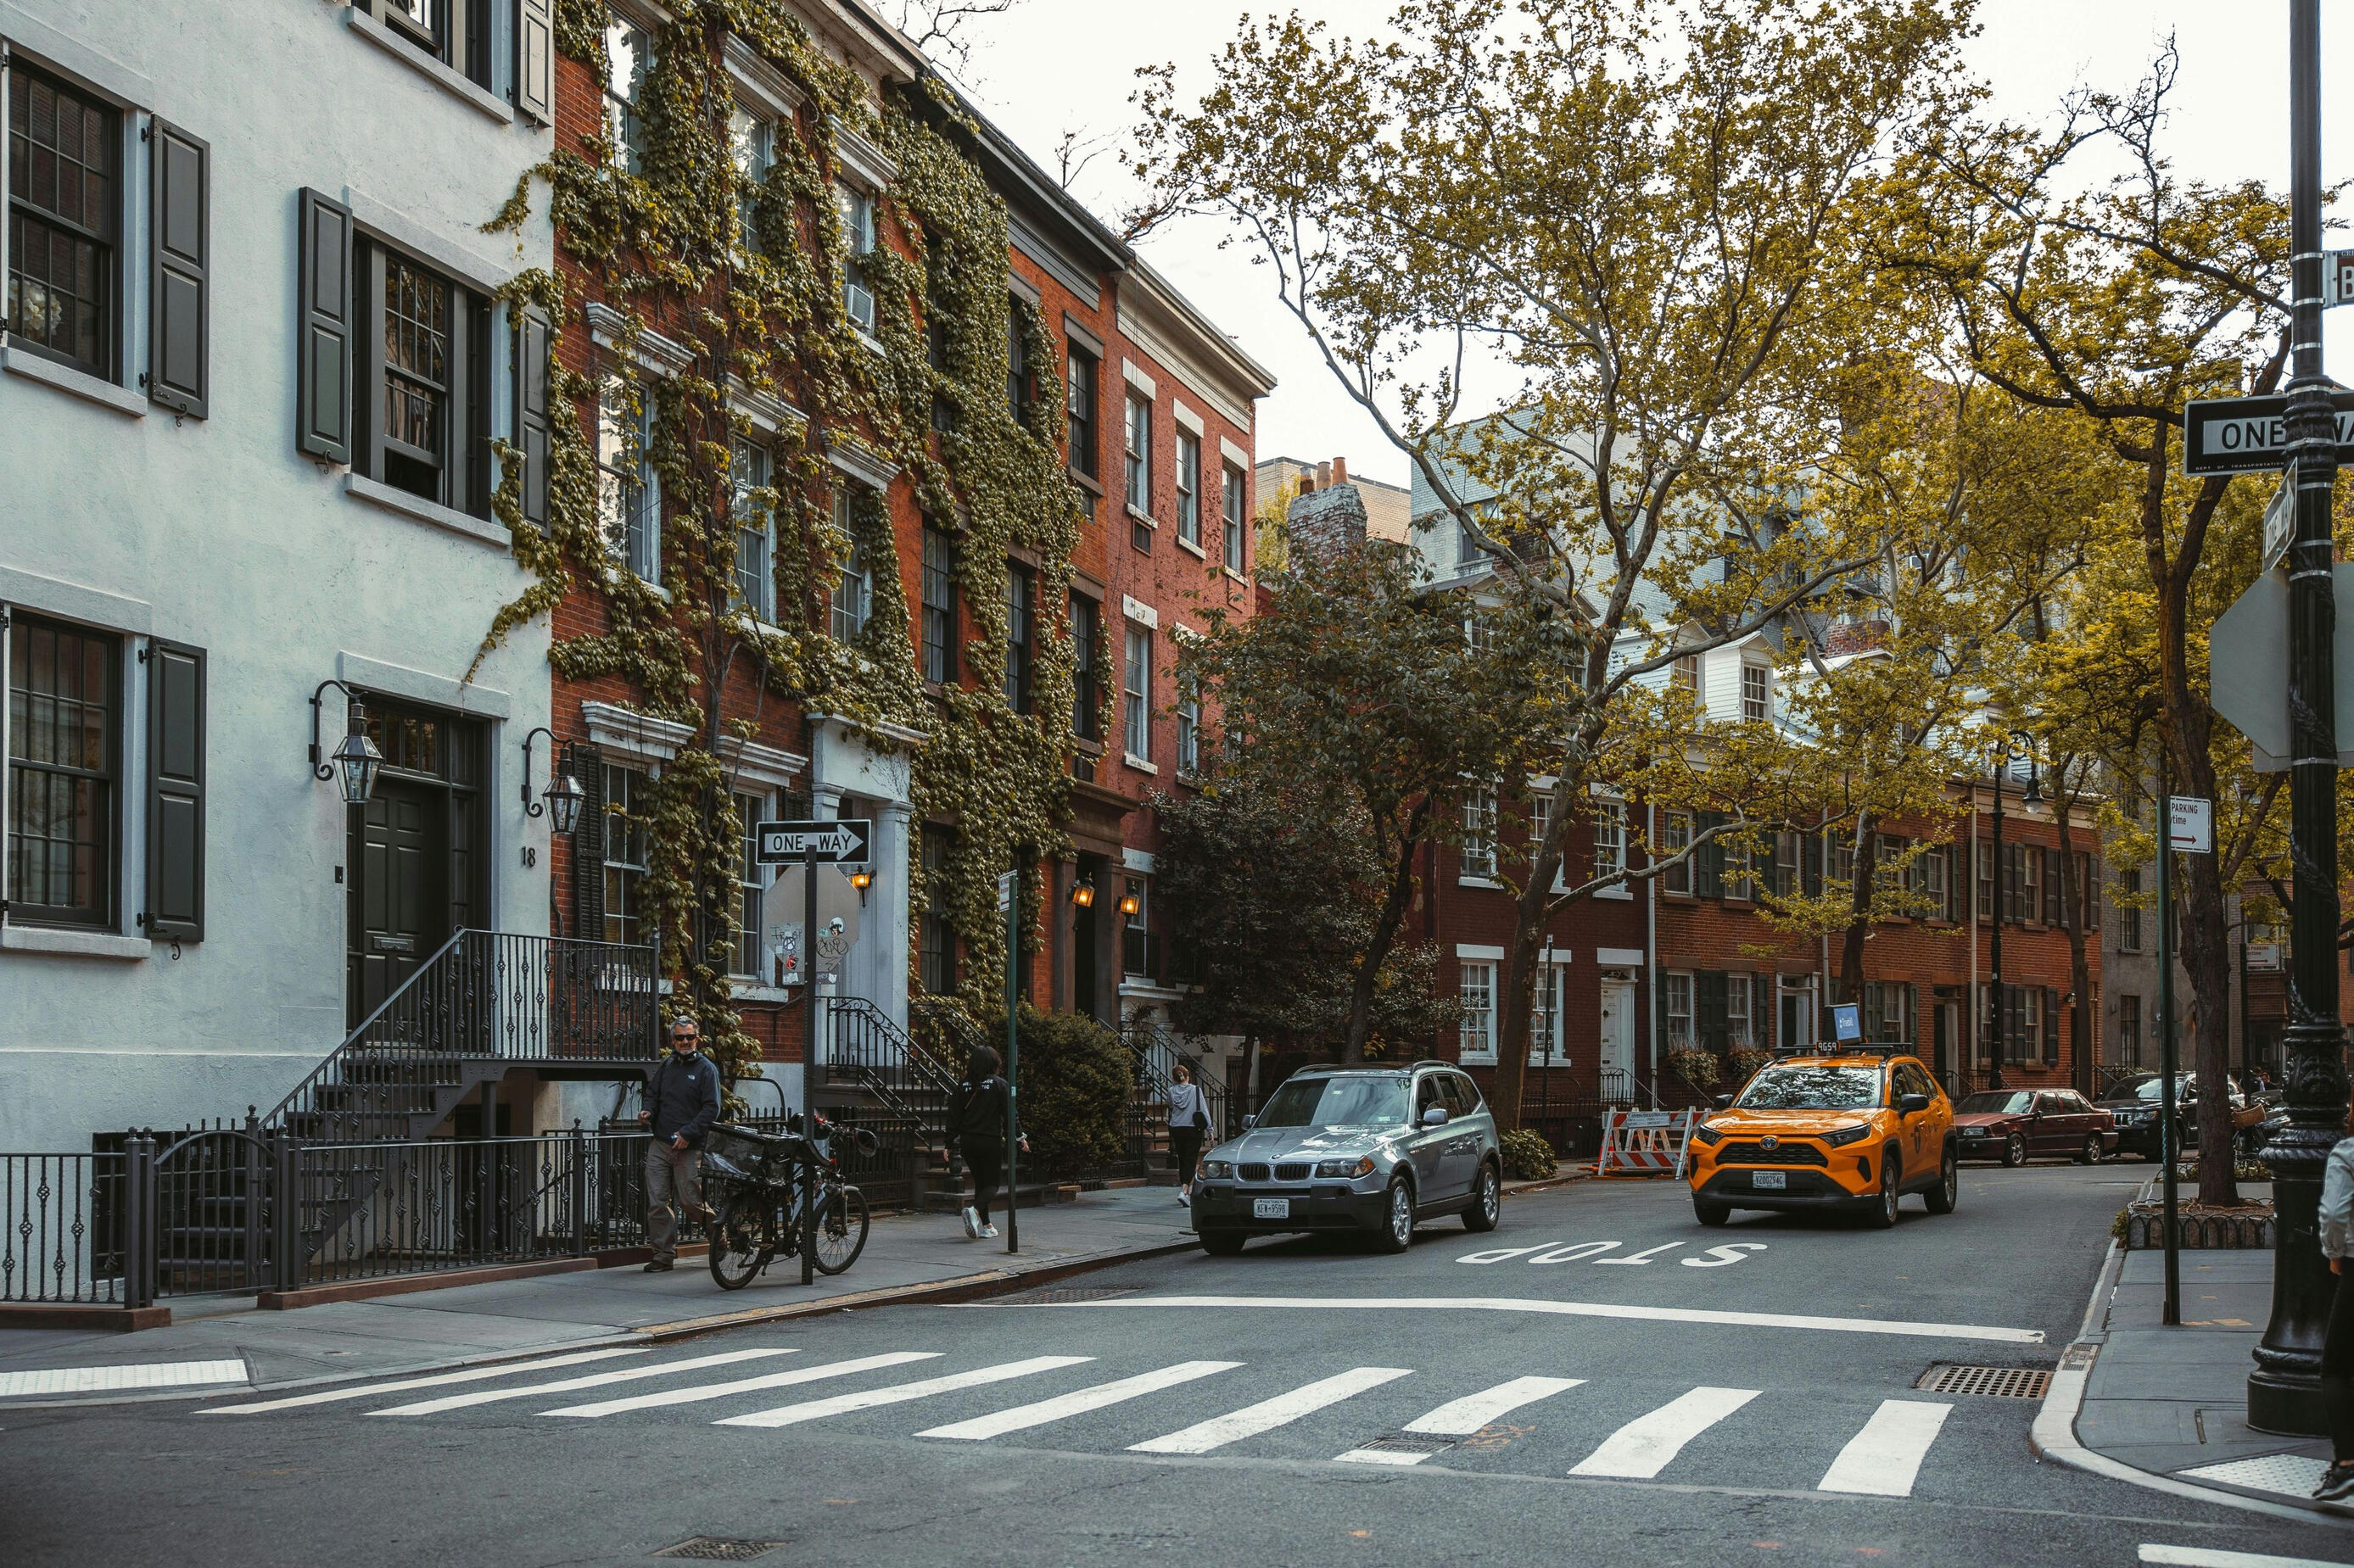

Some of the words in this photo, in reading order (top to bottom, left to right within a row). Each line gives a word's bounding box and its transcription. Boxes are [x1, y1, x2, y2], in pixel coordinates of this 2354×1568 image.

[2222, 421, 2284, 449] ONE
[2172, 802, 2198, 814] PARKING
[774, 835, 803, 851] ONE
[819, 834, 853, 851] WAY
[521, 845, 535, 868] 18
[1818, 1042, 1837, 1052] 9G59
[1455, 1241, 1768, 1267] STOP
